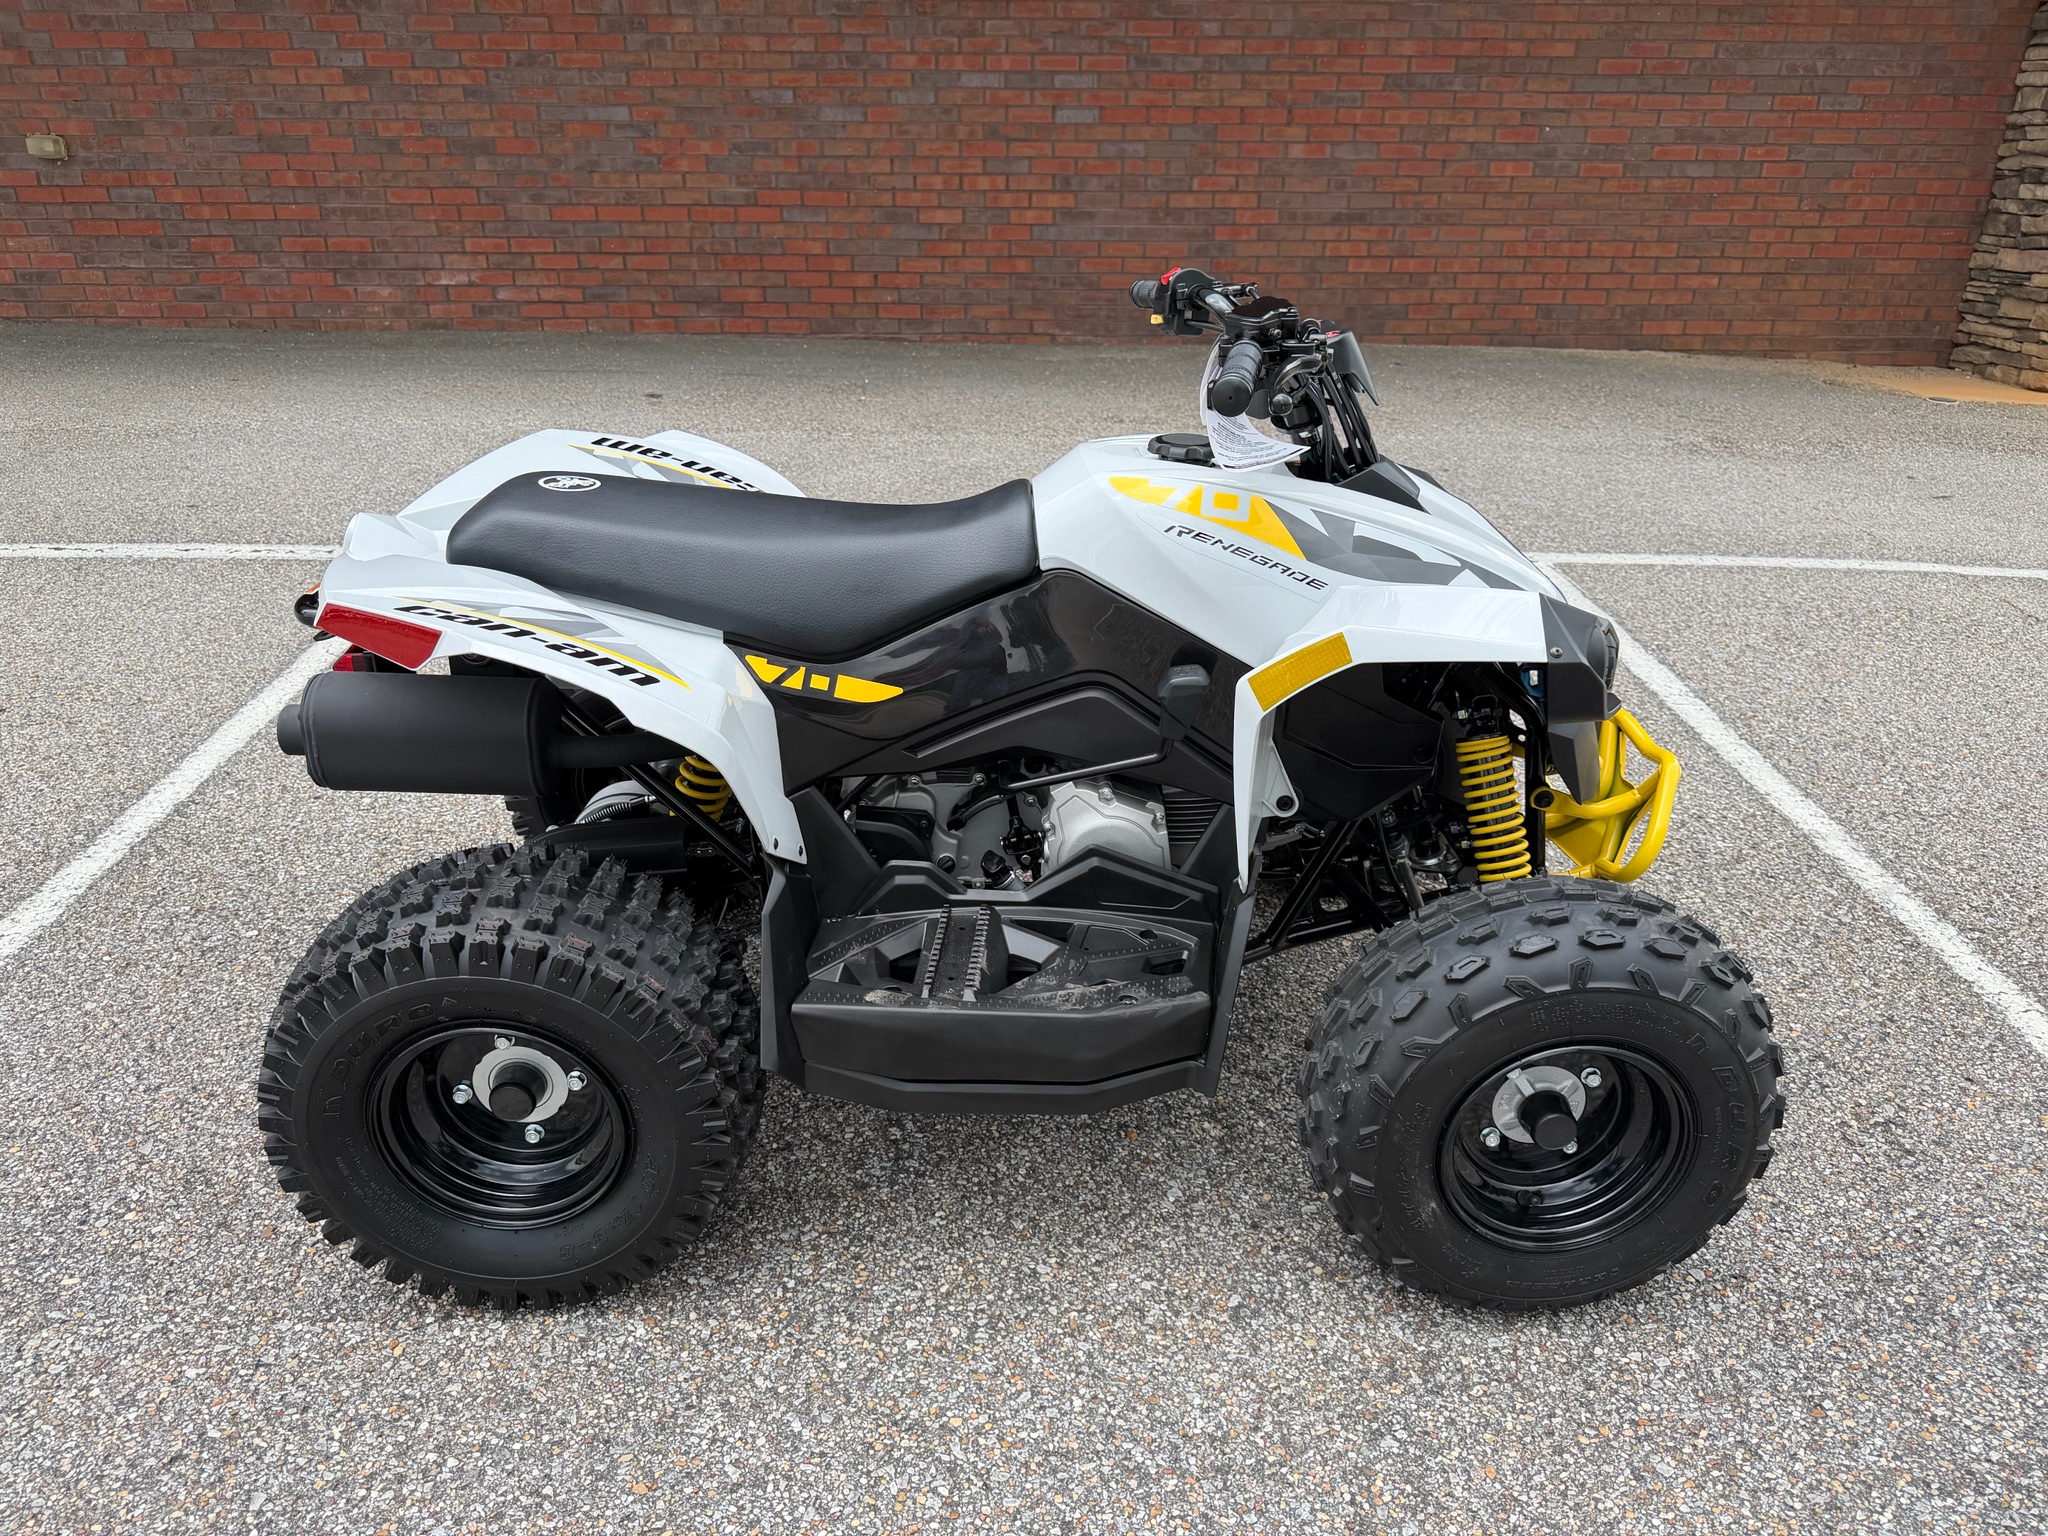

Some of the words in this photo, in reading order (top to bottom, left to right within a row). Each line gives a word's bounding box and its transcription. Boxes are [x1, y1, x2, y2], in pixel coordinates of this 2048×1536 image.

[1148, 477, 1251, 523] 70
[1163, 524, 1329, 590] RENEGADE
[393, 605, 661, 687] can-am
[330, 1003, 437, 1083] DURO
[1705, 1066, 1747, 1207] DURO
